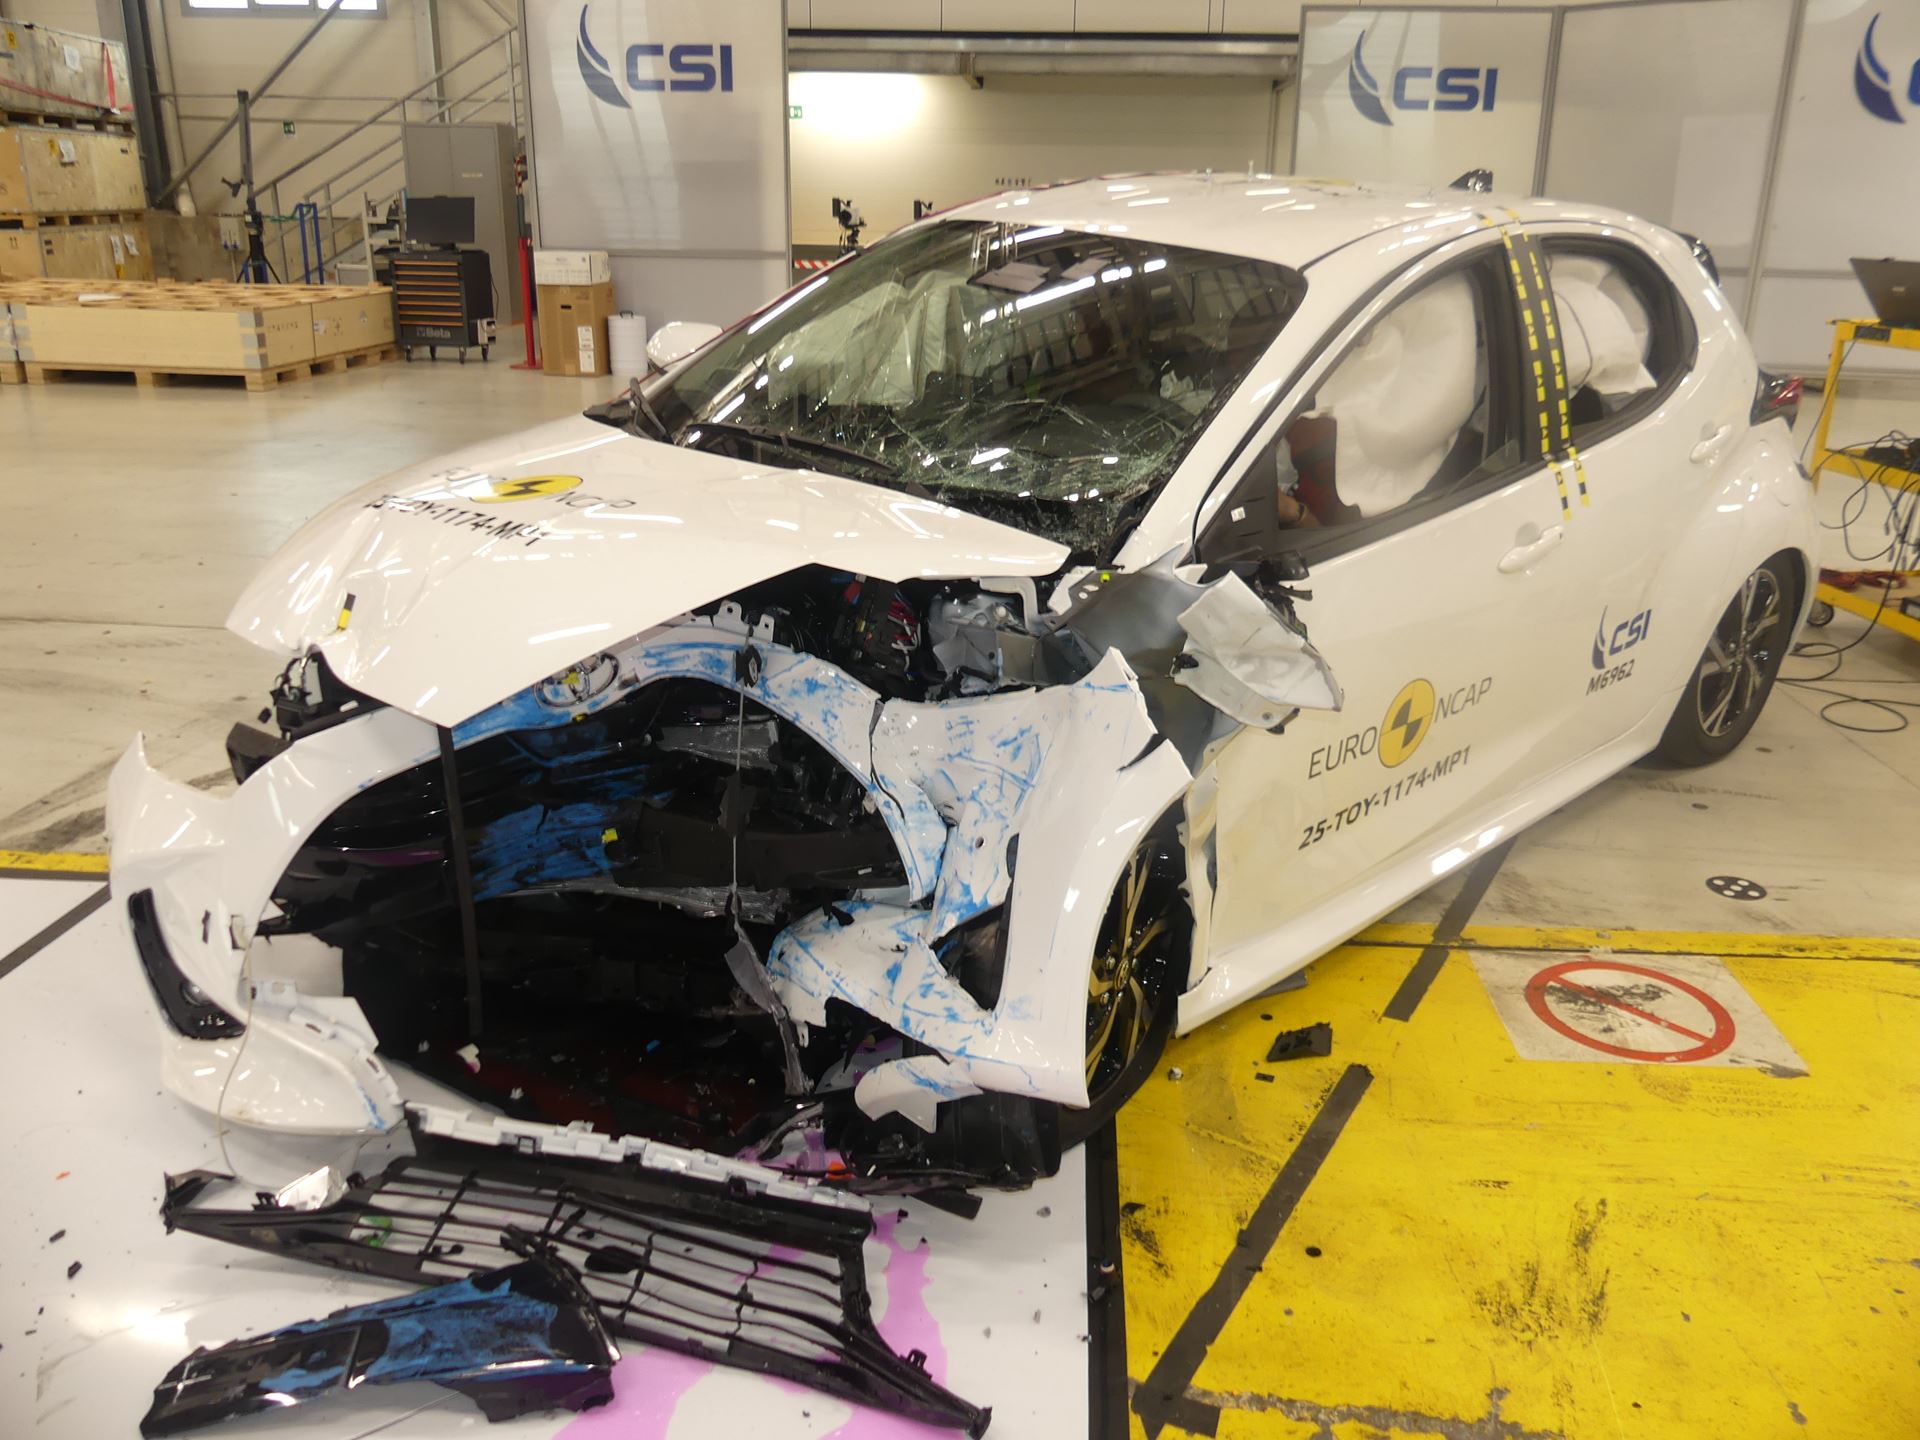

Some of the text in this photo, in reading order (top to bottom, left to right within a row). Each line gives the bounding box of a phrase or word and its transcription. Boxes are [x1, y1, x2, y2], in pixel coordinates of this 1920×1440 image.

[626, 44, 733, 92] CSI
[1393, 67, 1498, 111] CSI
[1609, 609, 1652, 656] CSI
[1585, 658, 1635, 696] M6962
[1308, 676, 1492, 779] EURO NCAP
[1298, 745, 1471, 851] 25-TOY-1174-MP1
